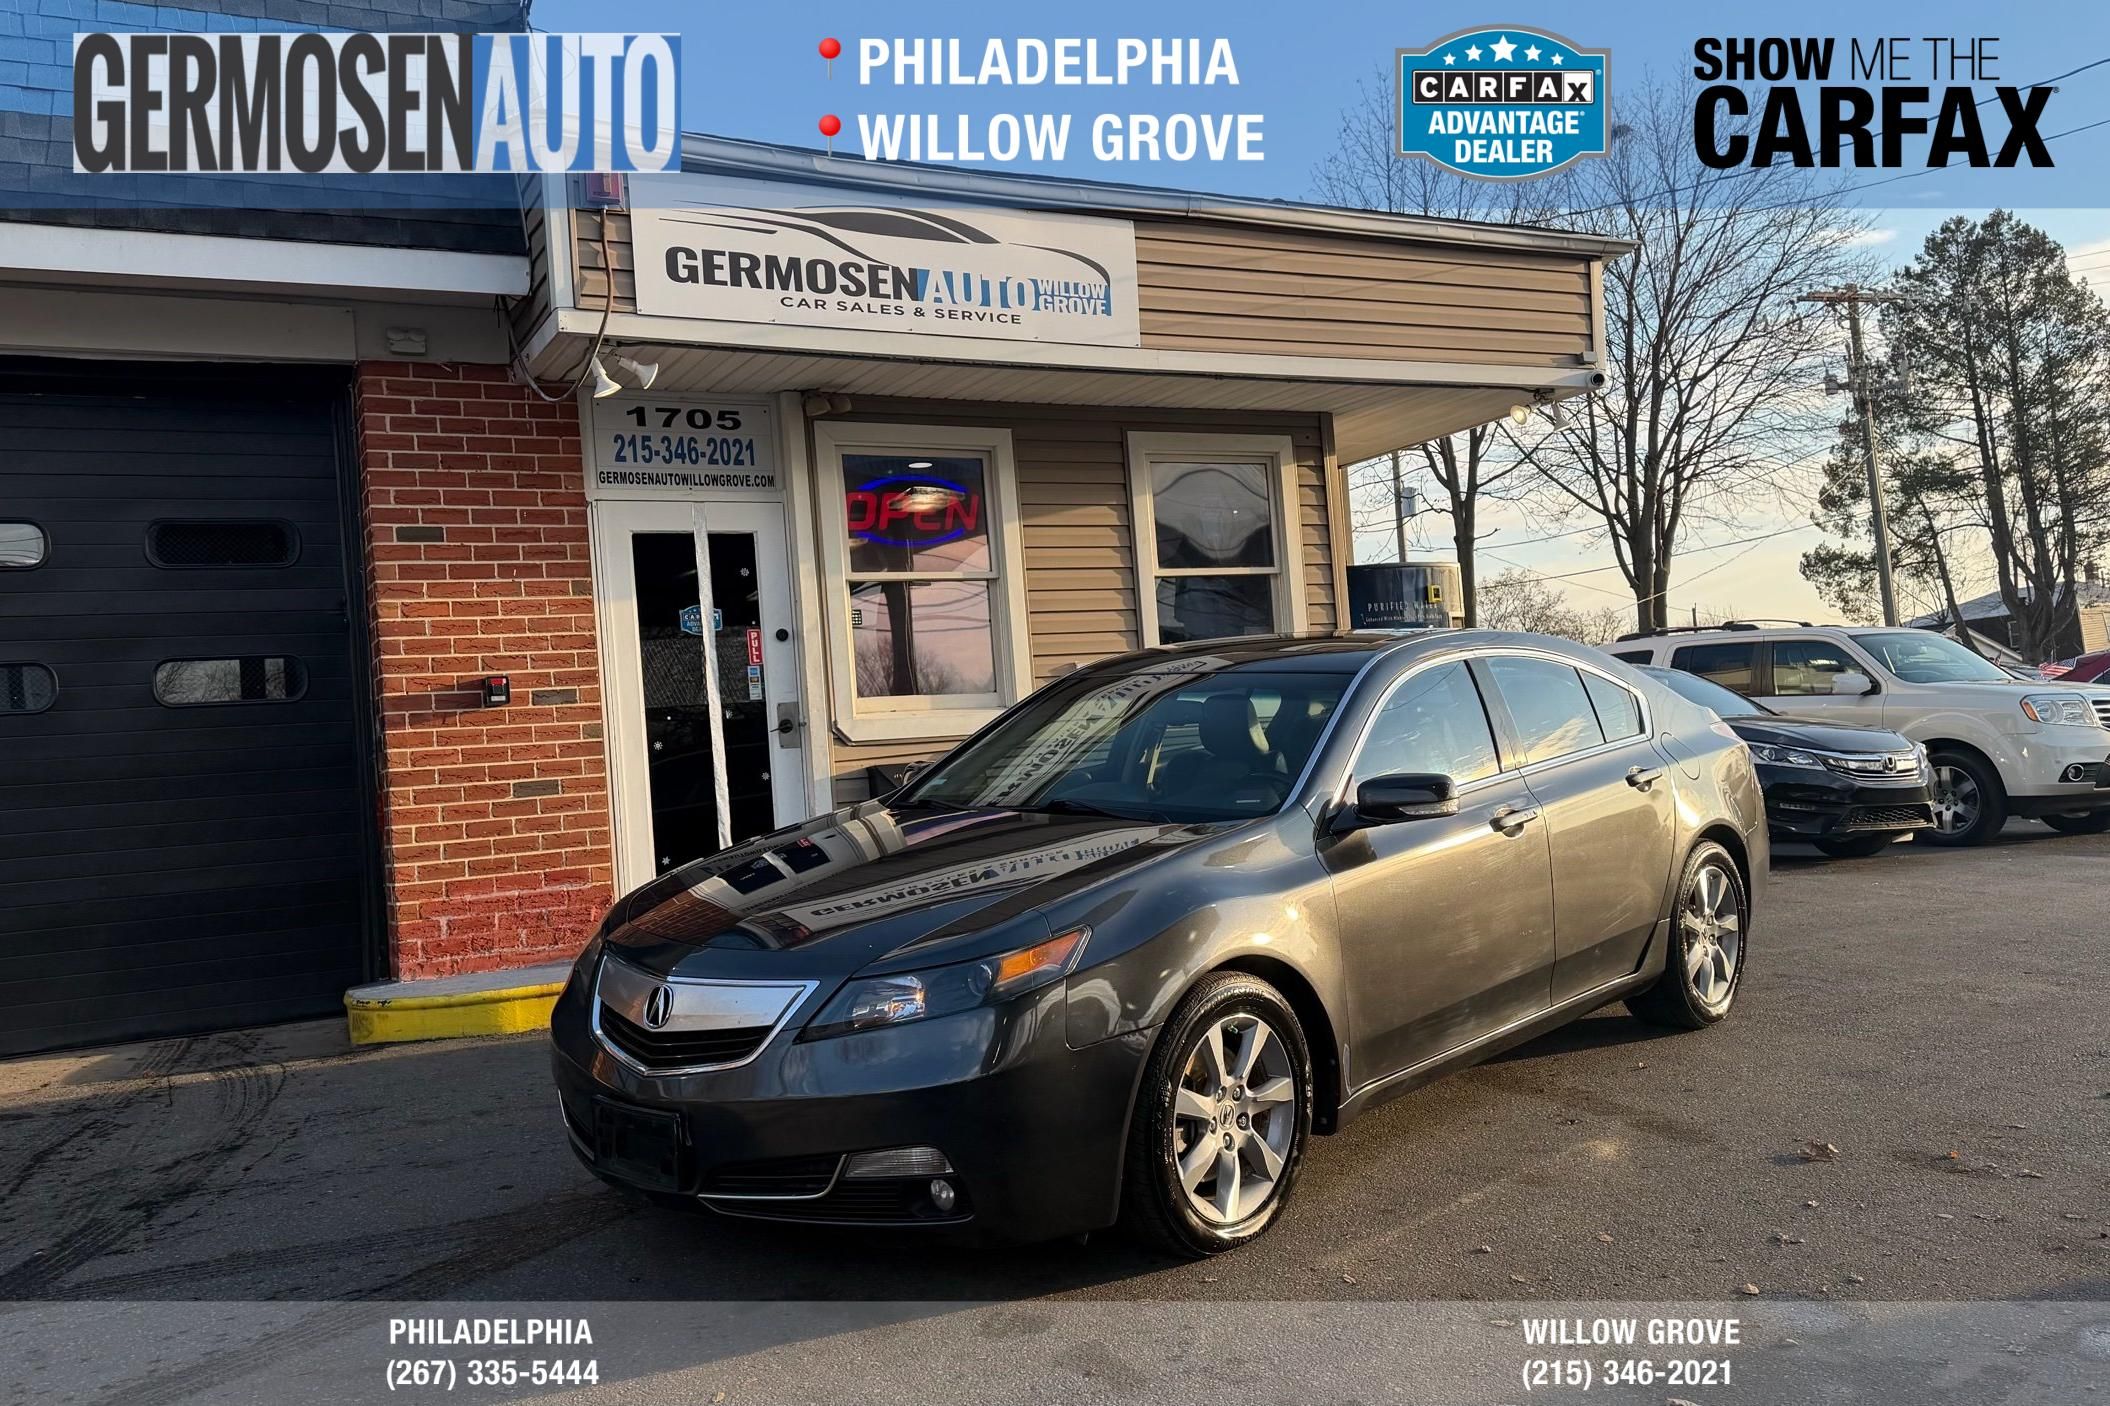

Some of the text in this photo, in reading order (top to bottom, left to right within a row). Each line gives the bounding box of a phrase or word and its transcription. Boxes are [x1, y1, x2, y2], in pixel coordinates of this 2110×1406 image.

[1039, 279, 1106, 299] WILLOW
[780, 296, 1023, 325] CAR SALES & SERVICE
[1039, 295, 1107, 315] GROVE
[626, 406, 742, 430] 1705
[614, 434, 755, 466] 215-346-2021
[599, 471, 775, 488] GERMOSENAUTOWILLOWGROVE.COM
[847, 491, 979, 531] OPEN
[751, 632, 760, 662] PULL
